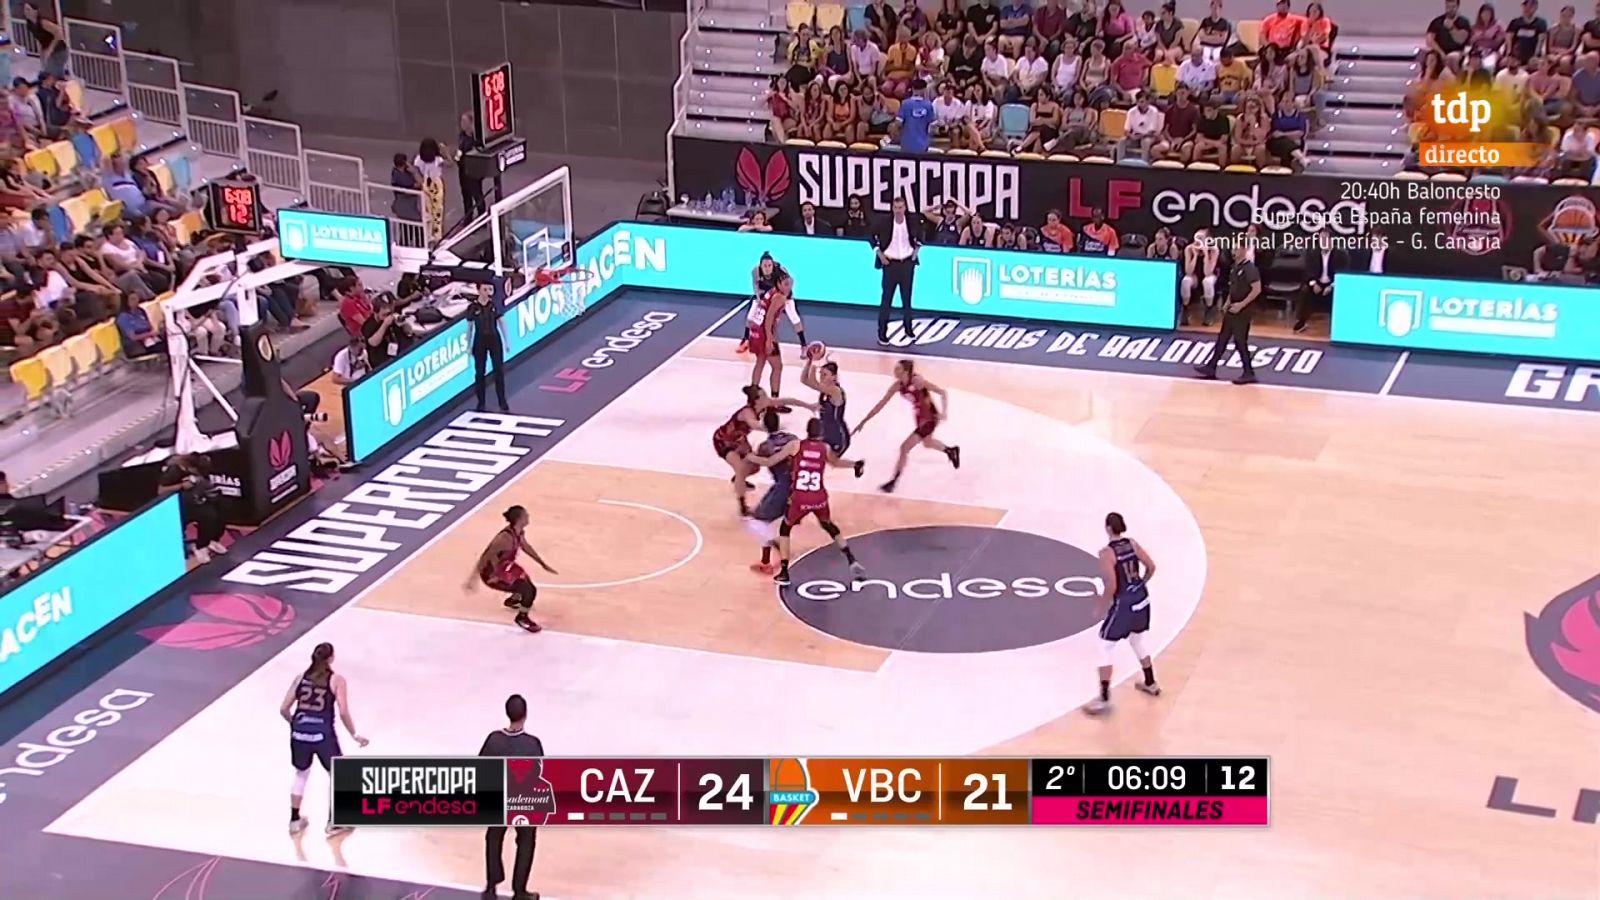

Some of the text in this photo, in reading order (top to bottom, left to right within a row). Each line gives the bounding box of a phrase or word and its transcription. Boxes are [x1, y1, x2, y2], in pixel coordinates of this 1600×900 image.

[489, 93, 504, 130] 12
[798, 153, 1020, 220] SUPERCOPA
[229, 205, 249, 225] 12
[1069, 177, 1368, 235] LF endesa
[518, 230, 667, 338] NOS HACEN
[998, 263, 1118, 290] LOTERÍAS
[1430, 296, 1559, 322] LOTERÍAS
[538, 311, 679, 394] LF endesa
[952, 323, 1048, 350] AÑOS
[1046, 331, 1101, 356] DE
[406, 331, 469, 386] LOTERÍAS
[795, 470, 821, 491] 23
[221, 410, 566, 594] SUPERCOPA
[796, 572, 1105, 600] endesa
[298, 685, 327, 711] 23
[0, 687, 155, 801] ndesa
